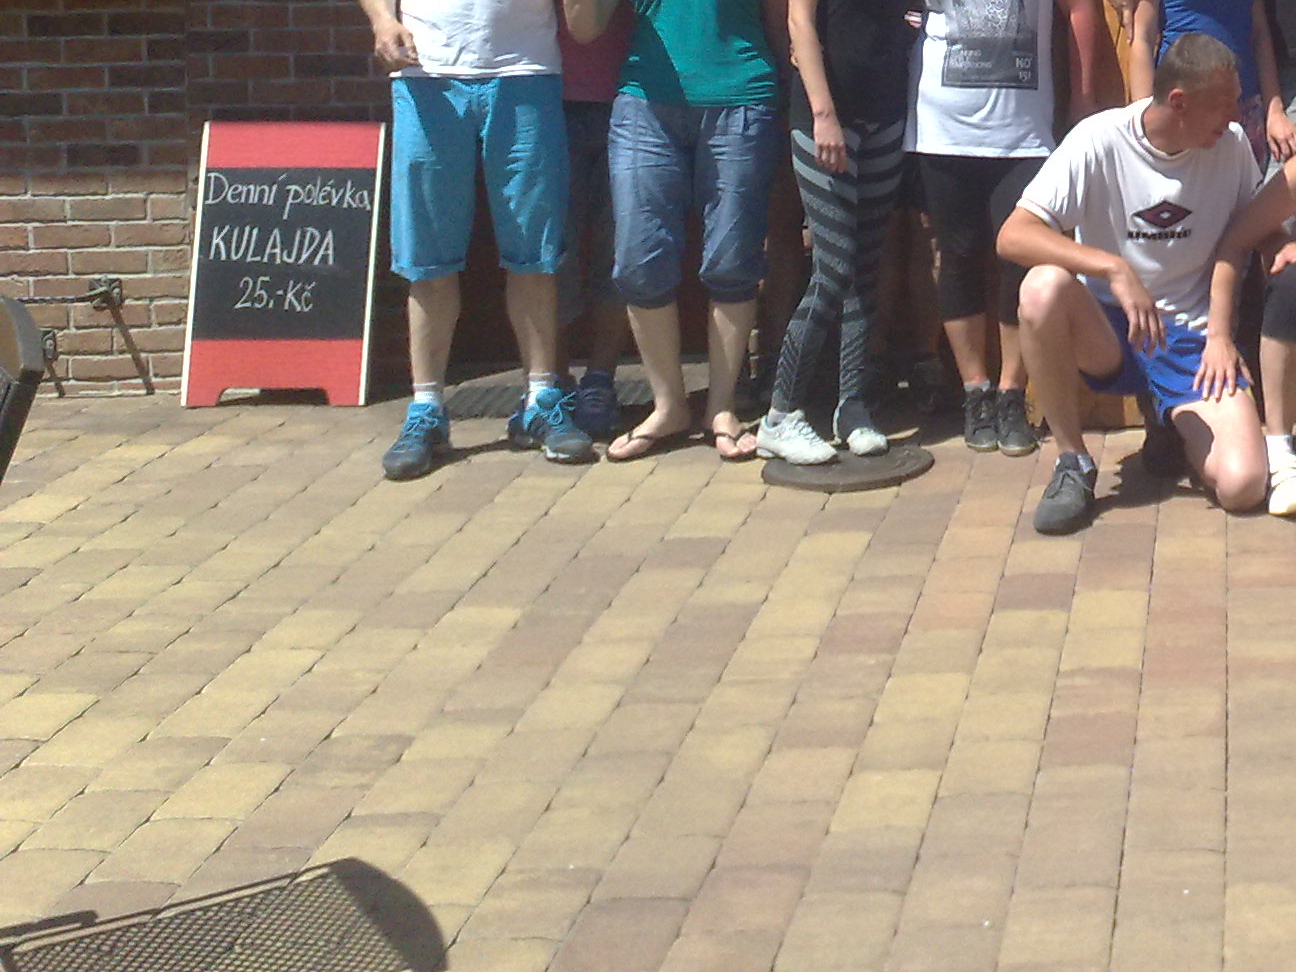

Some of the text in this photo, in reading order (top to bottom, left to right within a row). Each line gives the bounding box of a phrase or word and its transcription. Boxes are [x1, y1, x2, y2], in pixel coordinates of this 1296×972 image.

[205, 172, 371, 220] Denní polévka
[209, 224, 334, 266] KULAJDA
